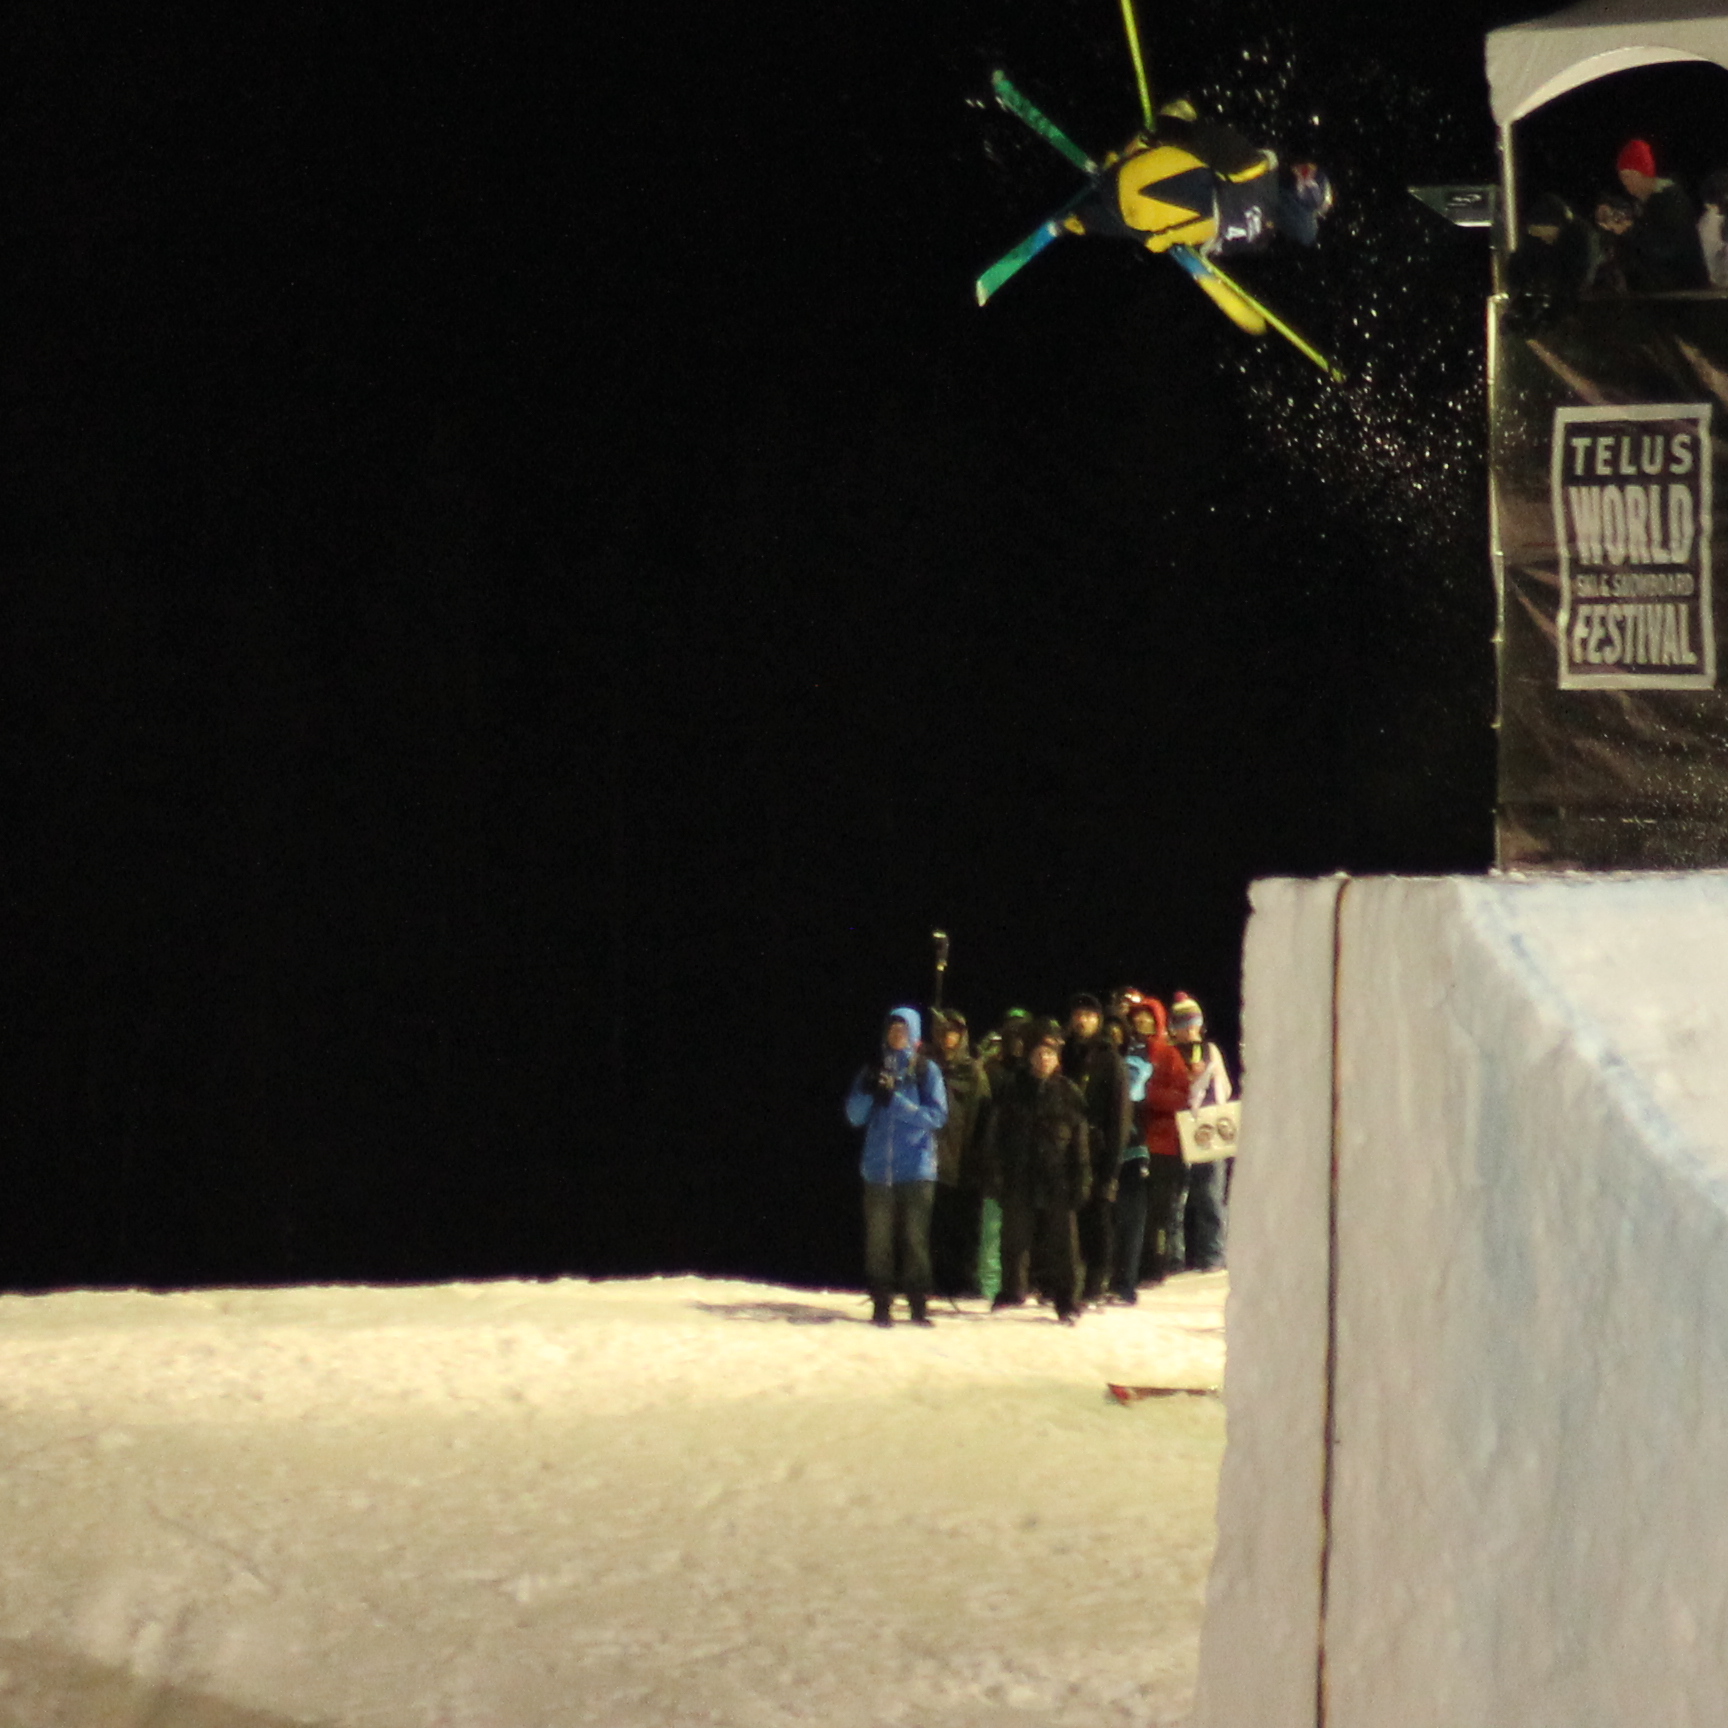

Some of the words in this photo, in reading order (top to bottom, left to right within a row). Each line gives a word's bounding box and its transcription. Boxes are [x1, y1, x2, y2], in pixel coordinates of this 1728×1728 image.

[1571, 433, 1693, 476] TELUS
[1569, 484, 1695, 565] WORLD
[1573, 604, 1698, 665] FESTIVAL
